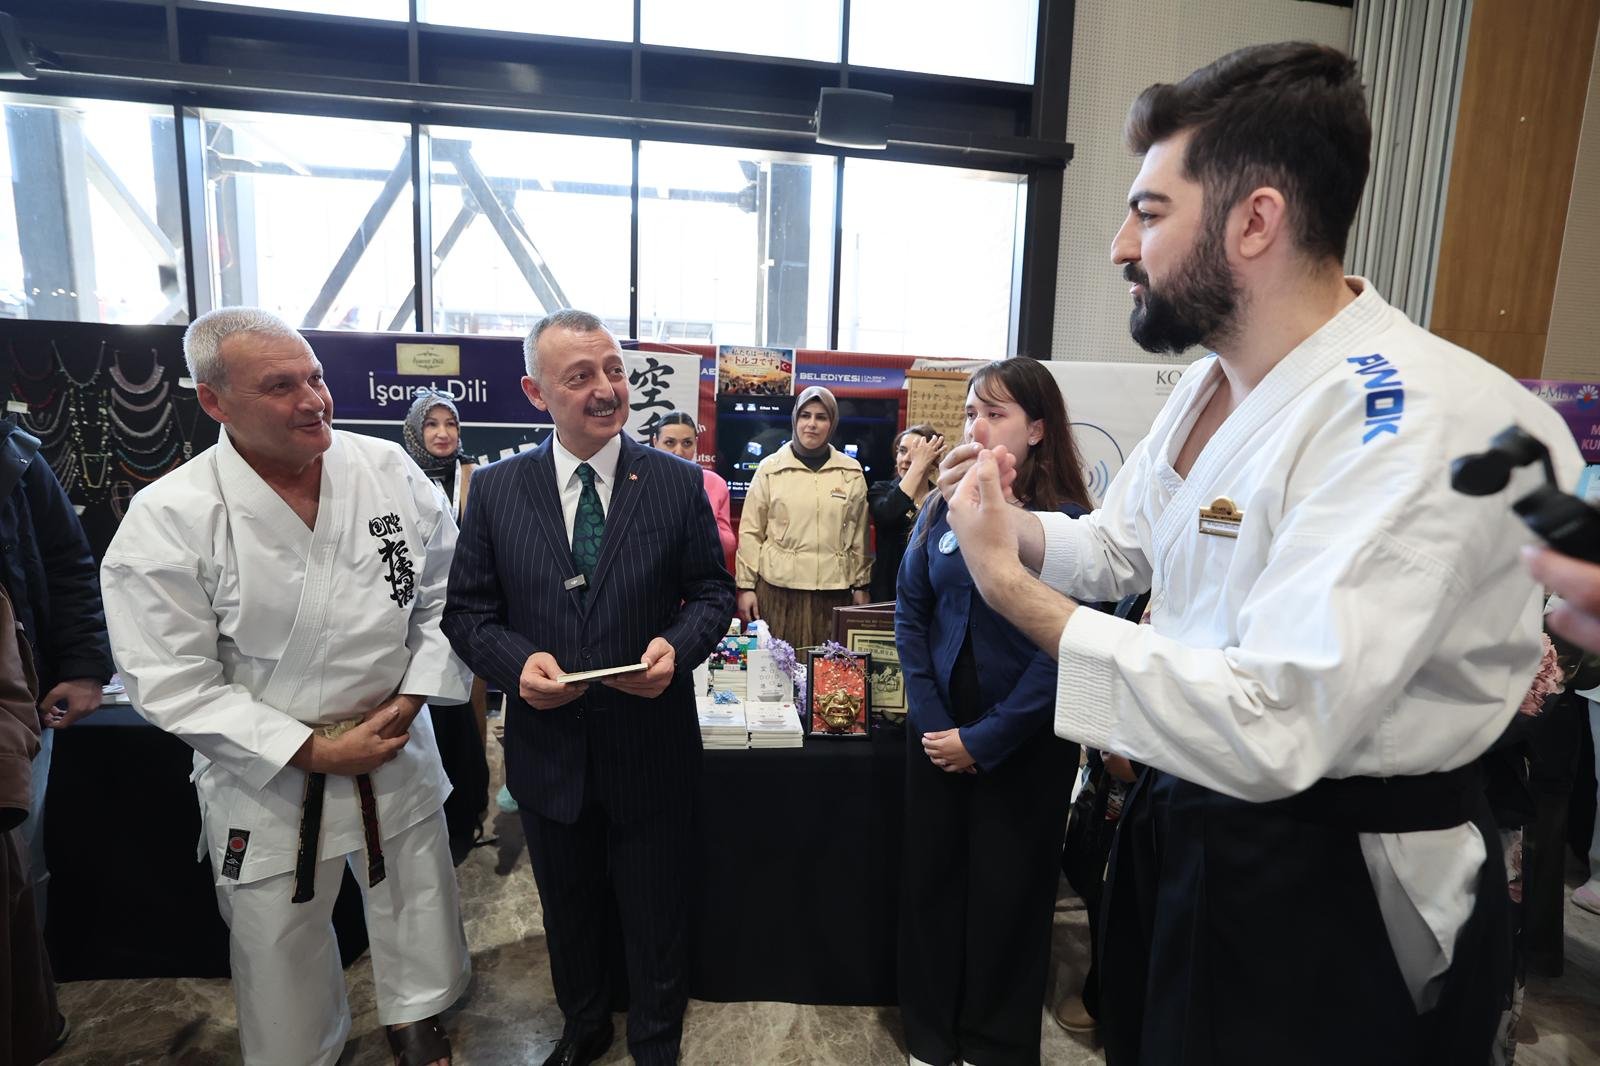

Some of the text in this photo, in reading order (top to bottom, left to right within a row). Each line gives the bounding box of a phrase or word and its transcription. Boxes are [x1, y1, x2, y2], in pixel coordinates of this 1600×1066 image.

[368, 371, 487, 407] İşaret Dili
[1157, 370, 1182, 386] KO
